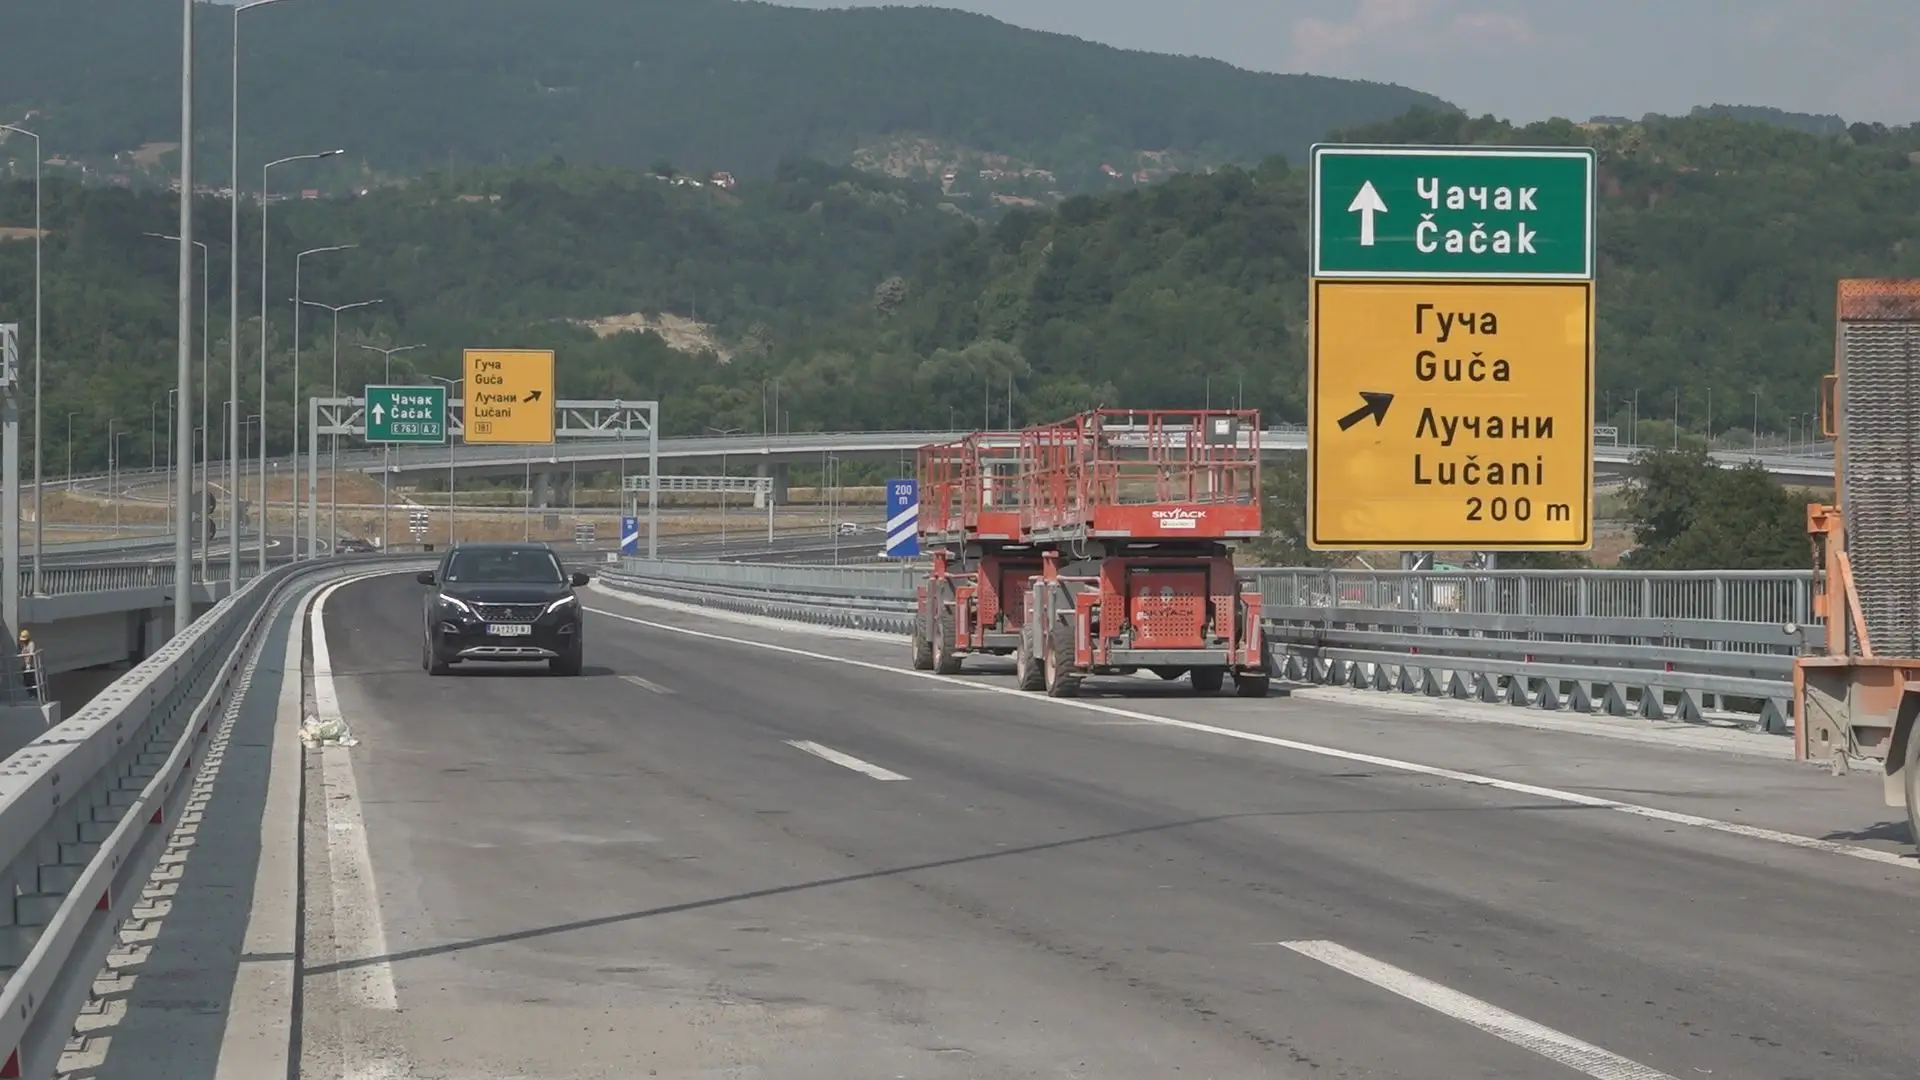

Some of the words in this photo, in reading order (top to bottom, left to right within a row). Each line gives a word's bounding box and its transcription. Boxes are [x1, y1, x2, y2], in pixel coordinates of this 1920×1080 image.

[1416, 177, 1538, 211] Чачак
[1416, 213, 1537, 254] Čačak
[1415, 303, 1498, 343] Гуча
[475, 358, 502, 372] Гуча
[1415, 350, 1510, 382] Guča
[391, 393, 433, 405] Чачак
[475, 391, 517, 405] Лучани
[391, 405, 433, 419] Čačak
[401, 424, 417, 433] 763
[1414, 407, 1554, 447] Лучани
[1414, 453, 1543, 485] Lučani
[895, 484, 913, 496] 200
[898, 496, 909, 505] m
[1151, 508, 1207, 520] SKYJACK
[1465, 496, 1532, 522] 200
[1546, 503, 1571, 522] m
